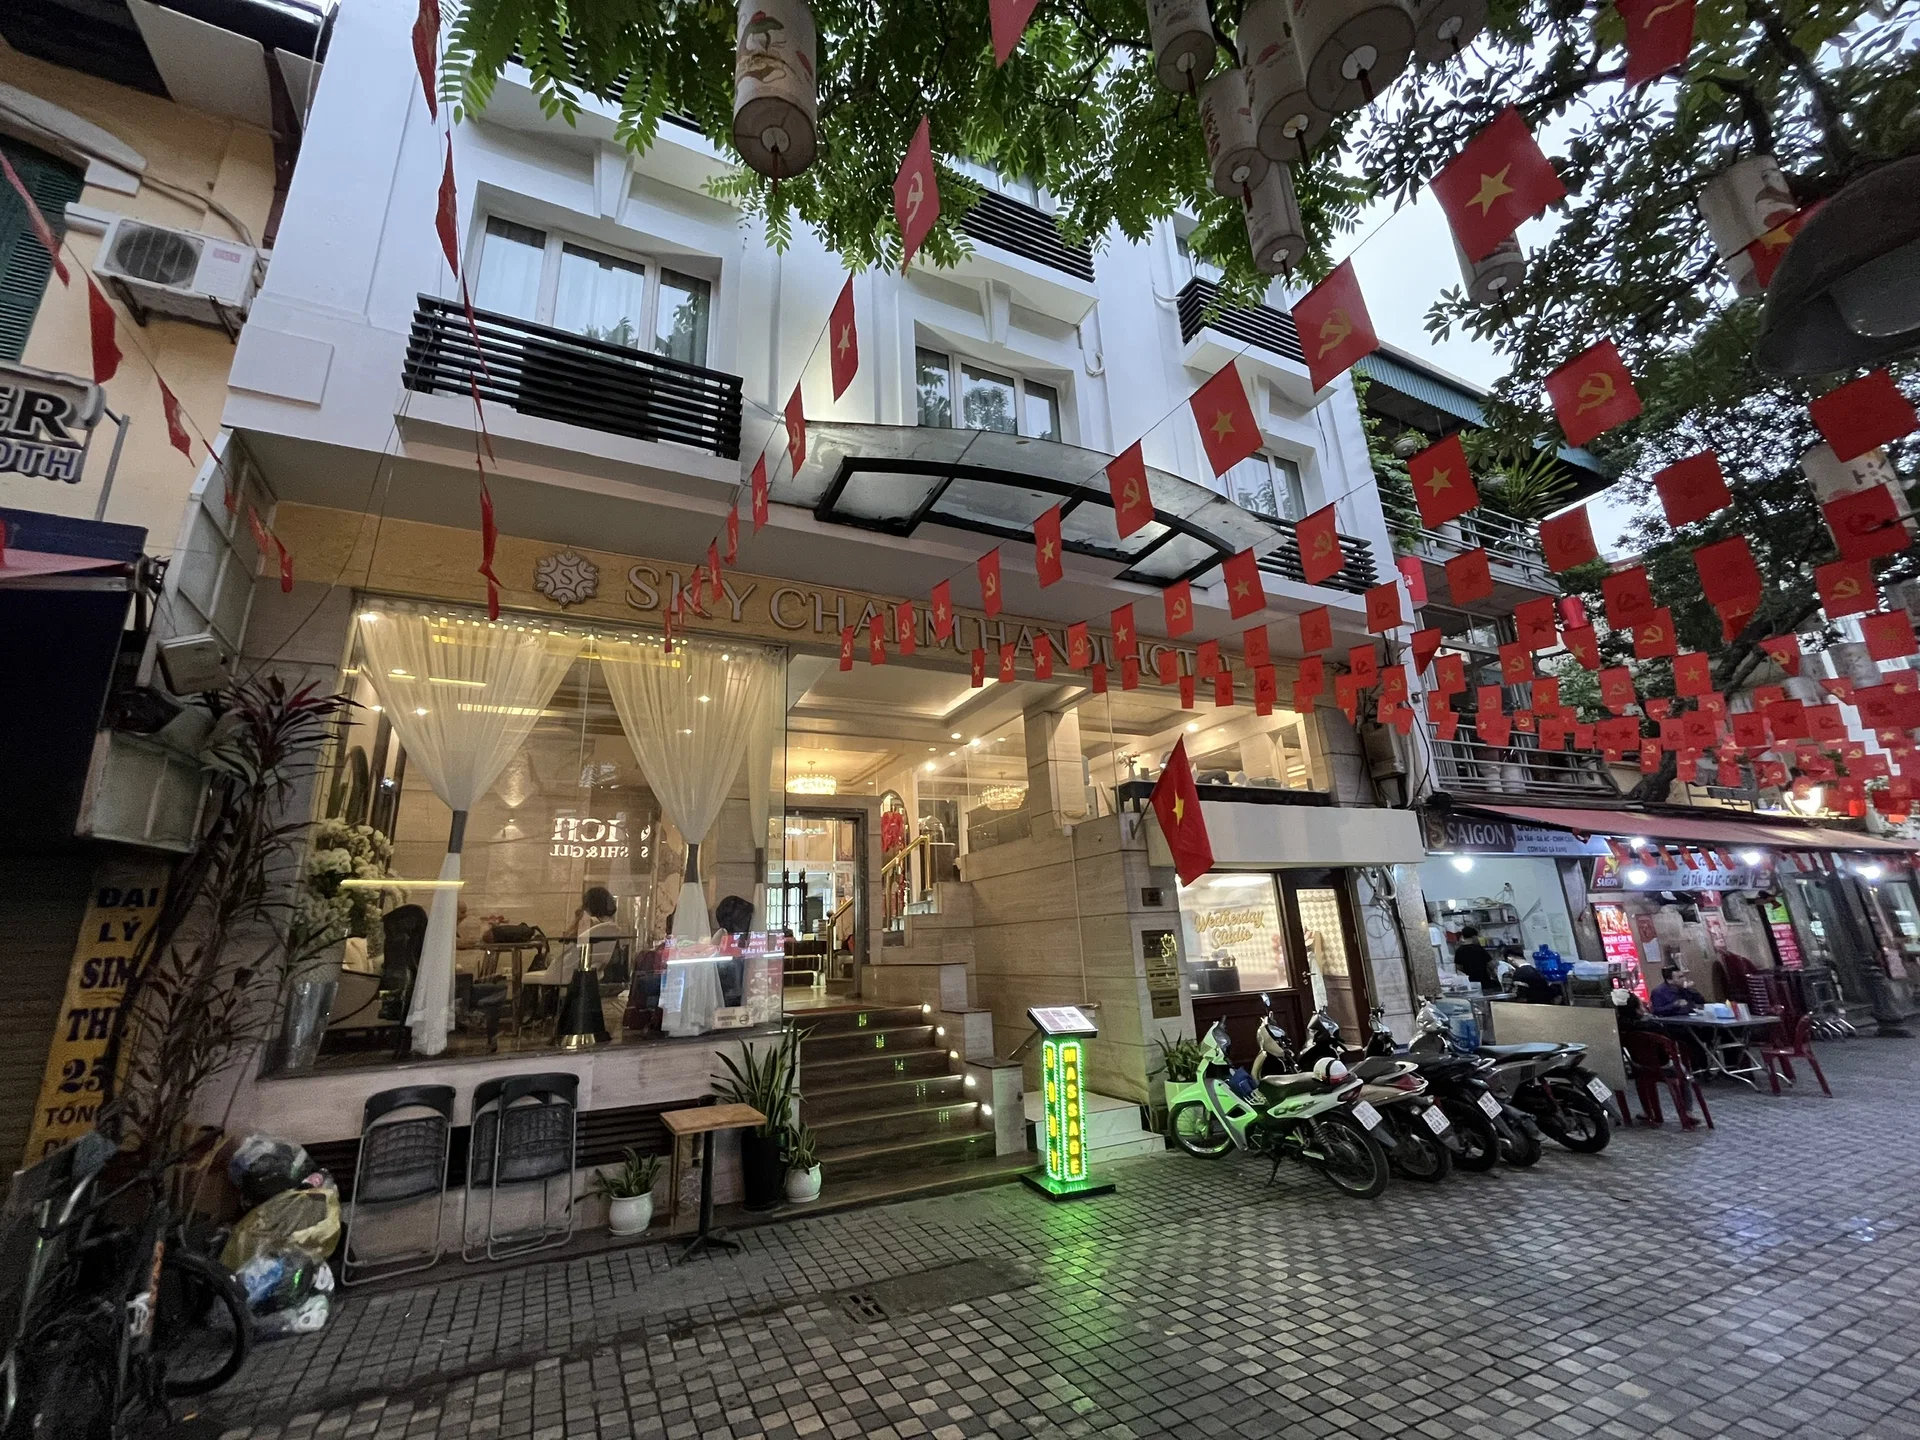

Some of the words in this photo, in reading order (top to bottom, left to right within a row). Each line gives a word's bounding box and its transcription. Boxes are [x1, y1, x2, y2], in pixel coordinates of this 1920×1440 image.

[625, 564, 757, 622] SKY
[1446, 823, 1506, 845] SAIGON
[98, 916, 142, 943] LÝ
[1193, 907, 1266, 934] Wednesday
[1211, 927, 1254, 949] Studio
[66, 1008, 118, 1042] TH
[1063, 1048, 1081, 1175] MASSAGE
